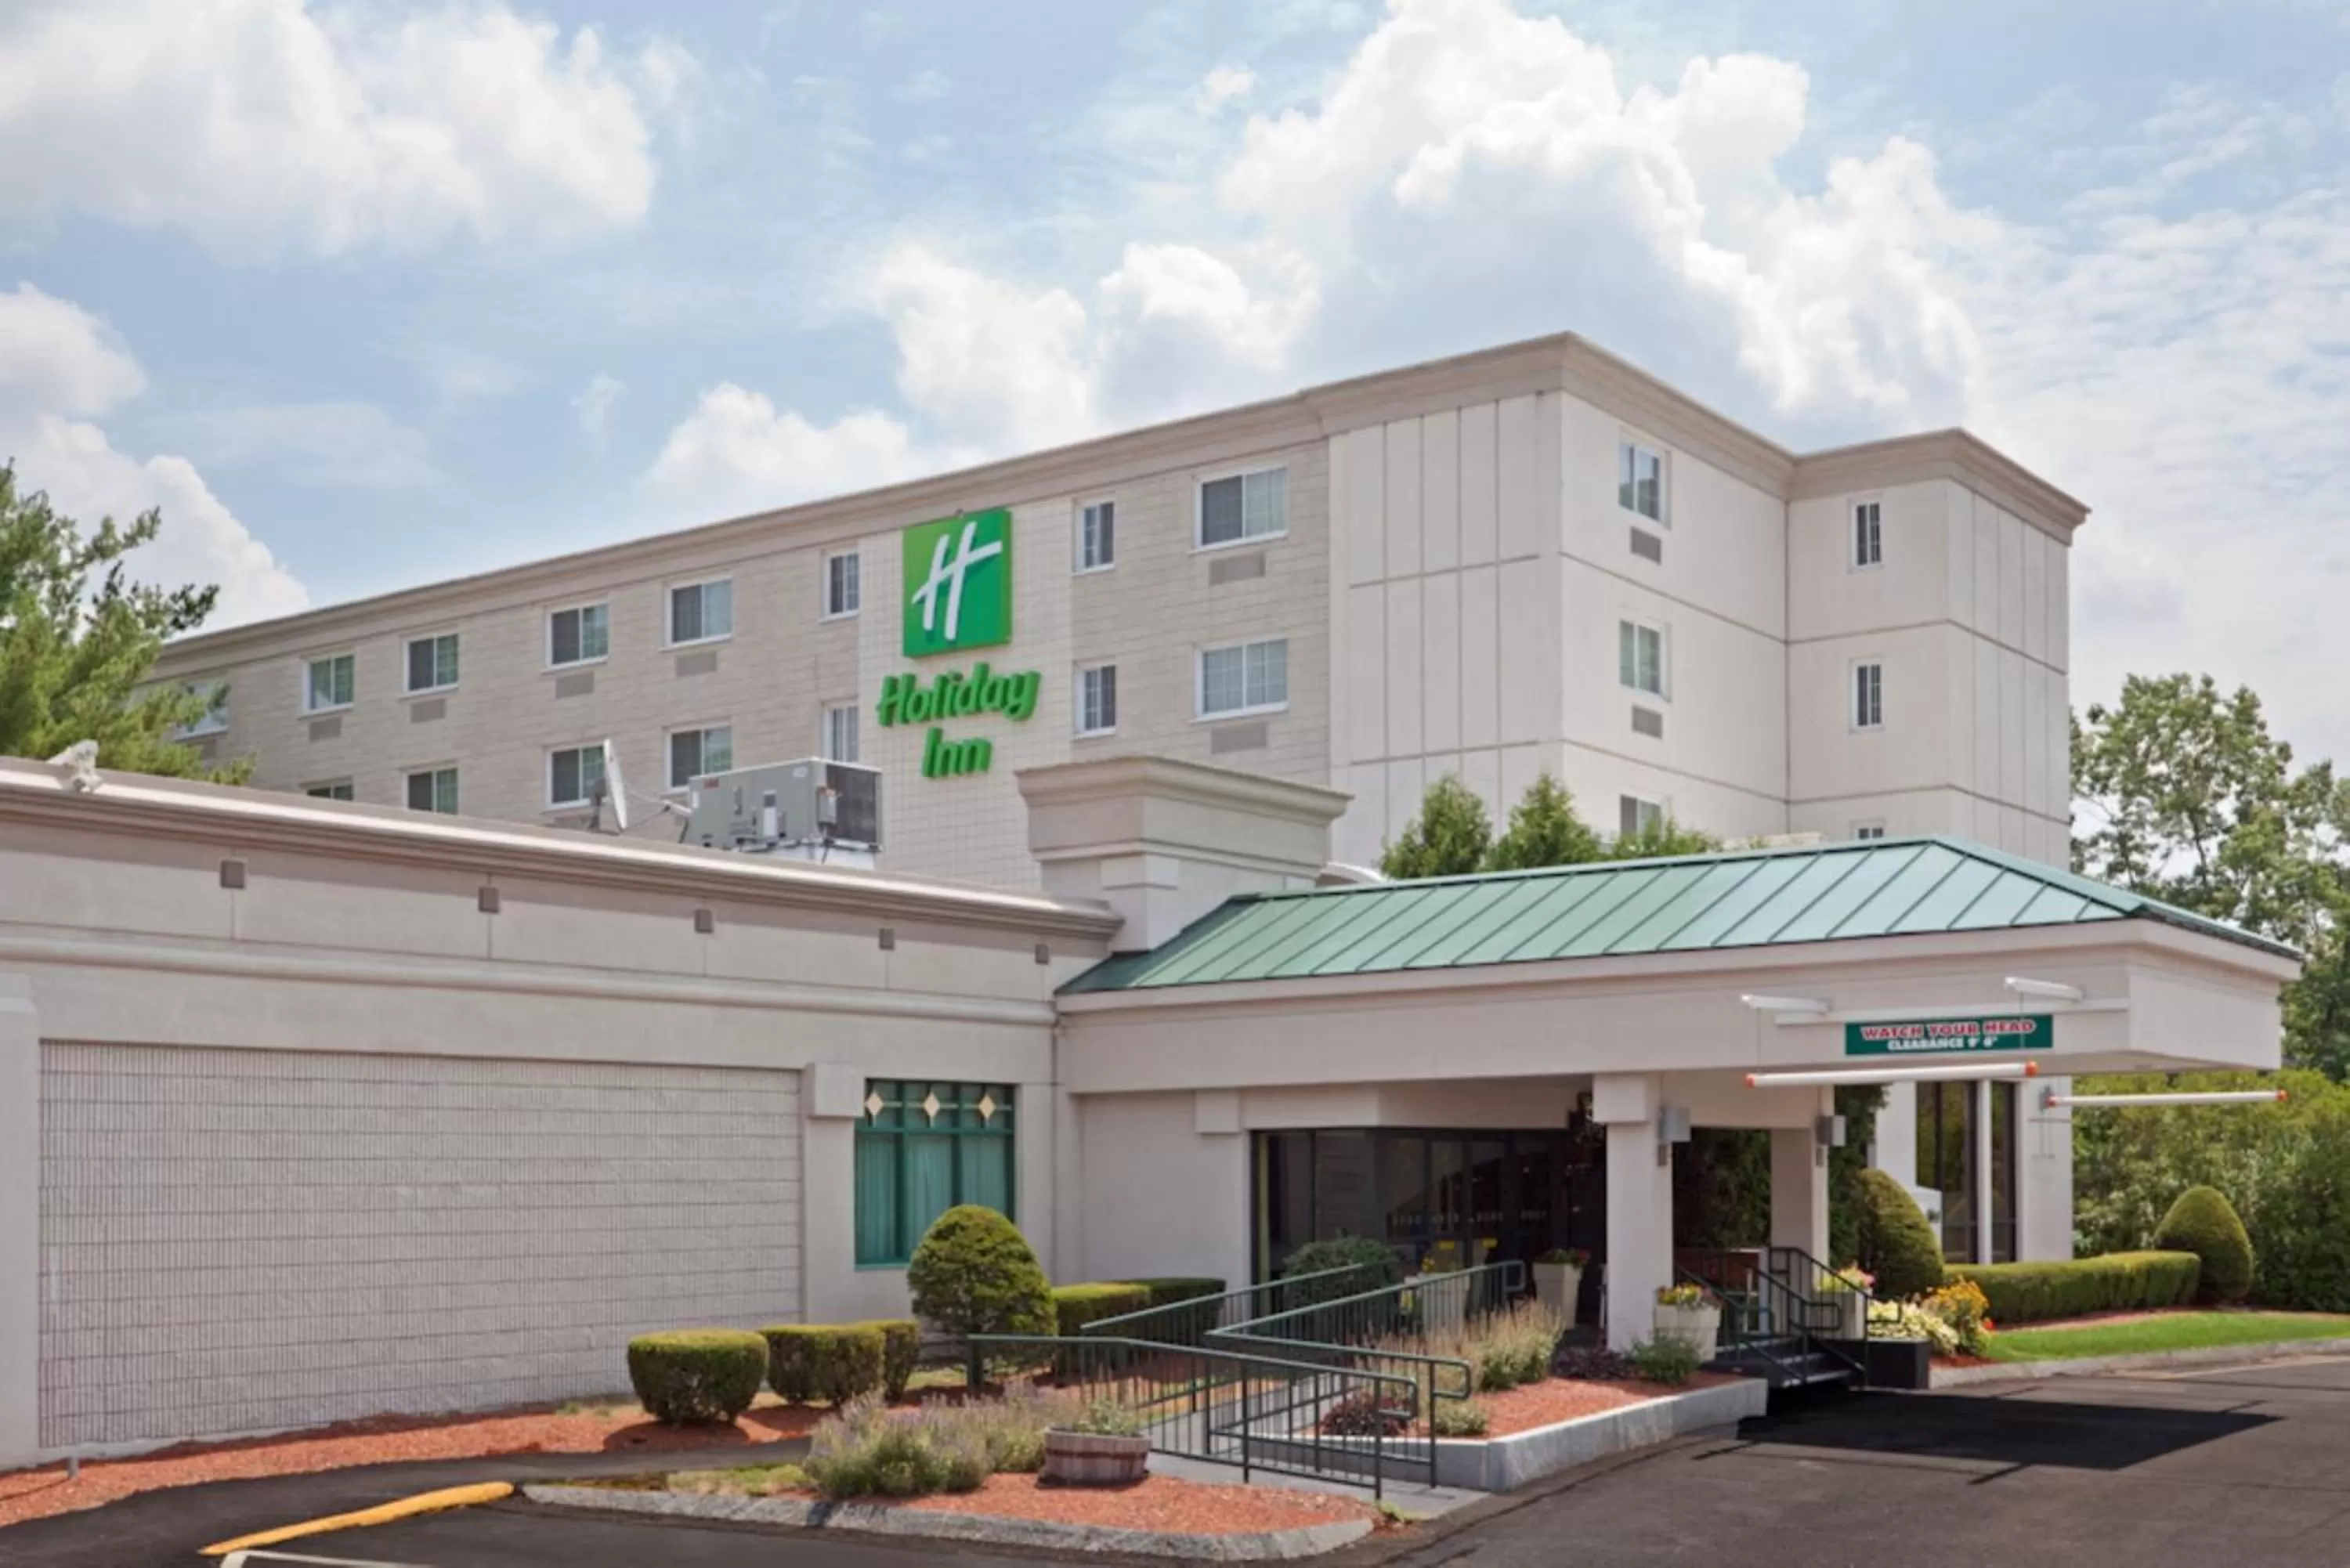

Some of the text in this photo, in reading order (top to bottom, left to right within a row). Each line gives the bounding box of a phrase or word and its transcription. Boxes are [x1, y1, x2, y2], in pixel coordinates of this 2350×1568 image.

[877, 662, 1041, 728] Holiday
[921, 727, 992, 779] Inn
[1860, 1019, 2036, 1040] WATCH YOUR HEAD
[1887, 1038, 1964, 1050] CLEARANCE
